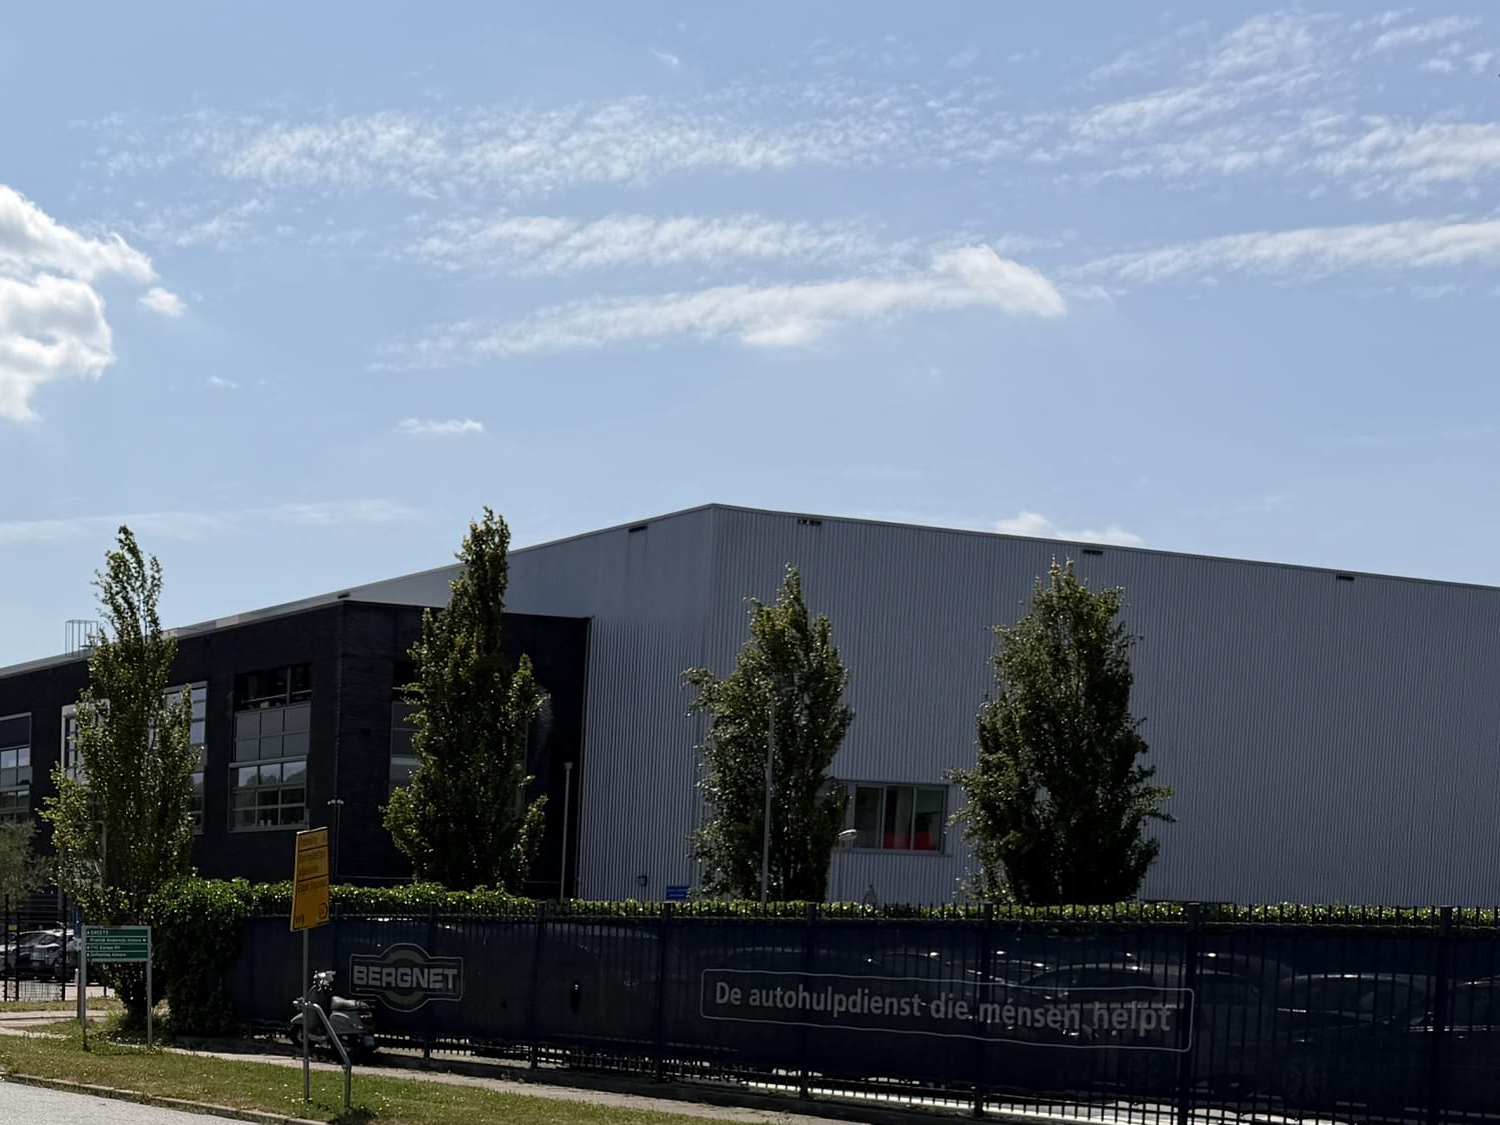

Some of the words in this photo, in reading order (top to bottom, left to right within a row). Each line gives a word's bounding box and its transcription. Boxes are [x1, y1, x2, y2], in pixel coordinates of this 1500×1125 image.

[353, 965, 458, 989] BERGNET
[716, 981, 742, 1005] De
[749, 984, 921, 1018] autohulpdienst
[930, 992, 969, 1020] die
[978, 1002, 1080, 1028] mensen
[1092, 1000, 1170, 1036] helpt
